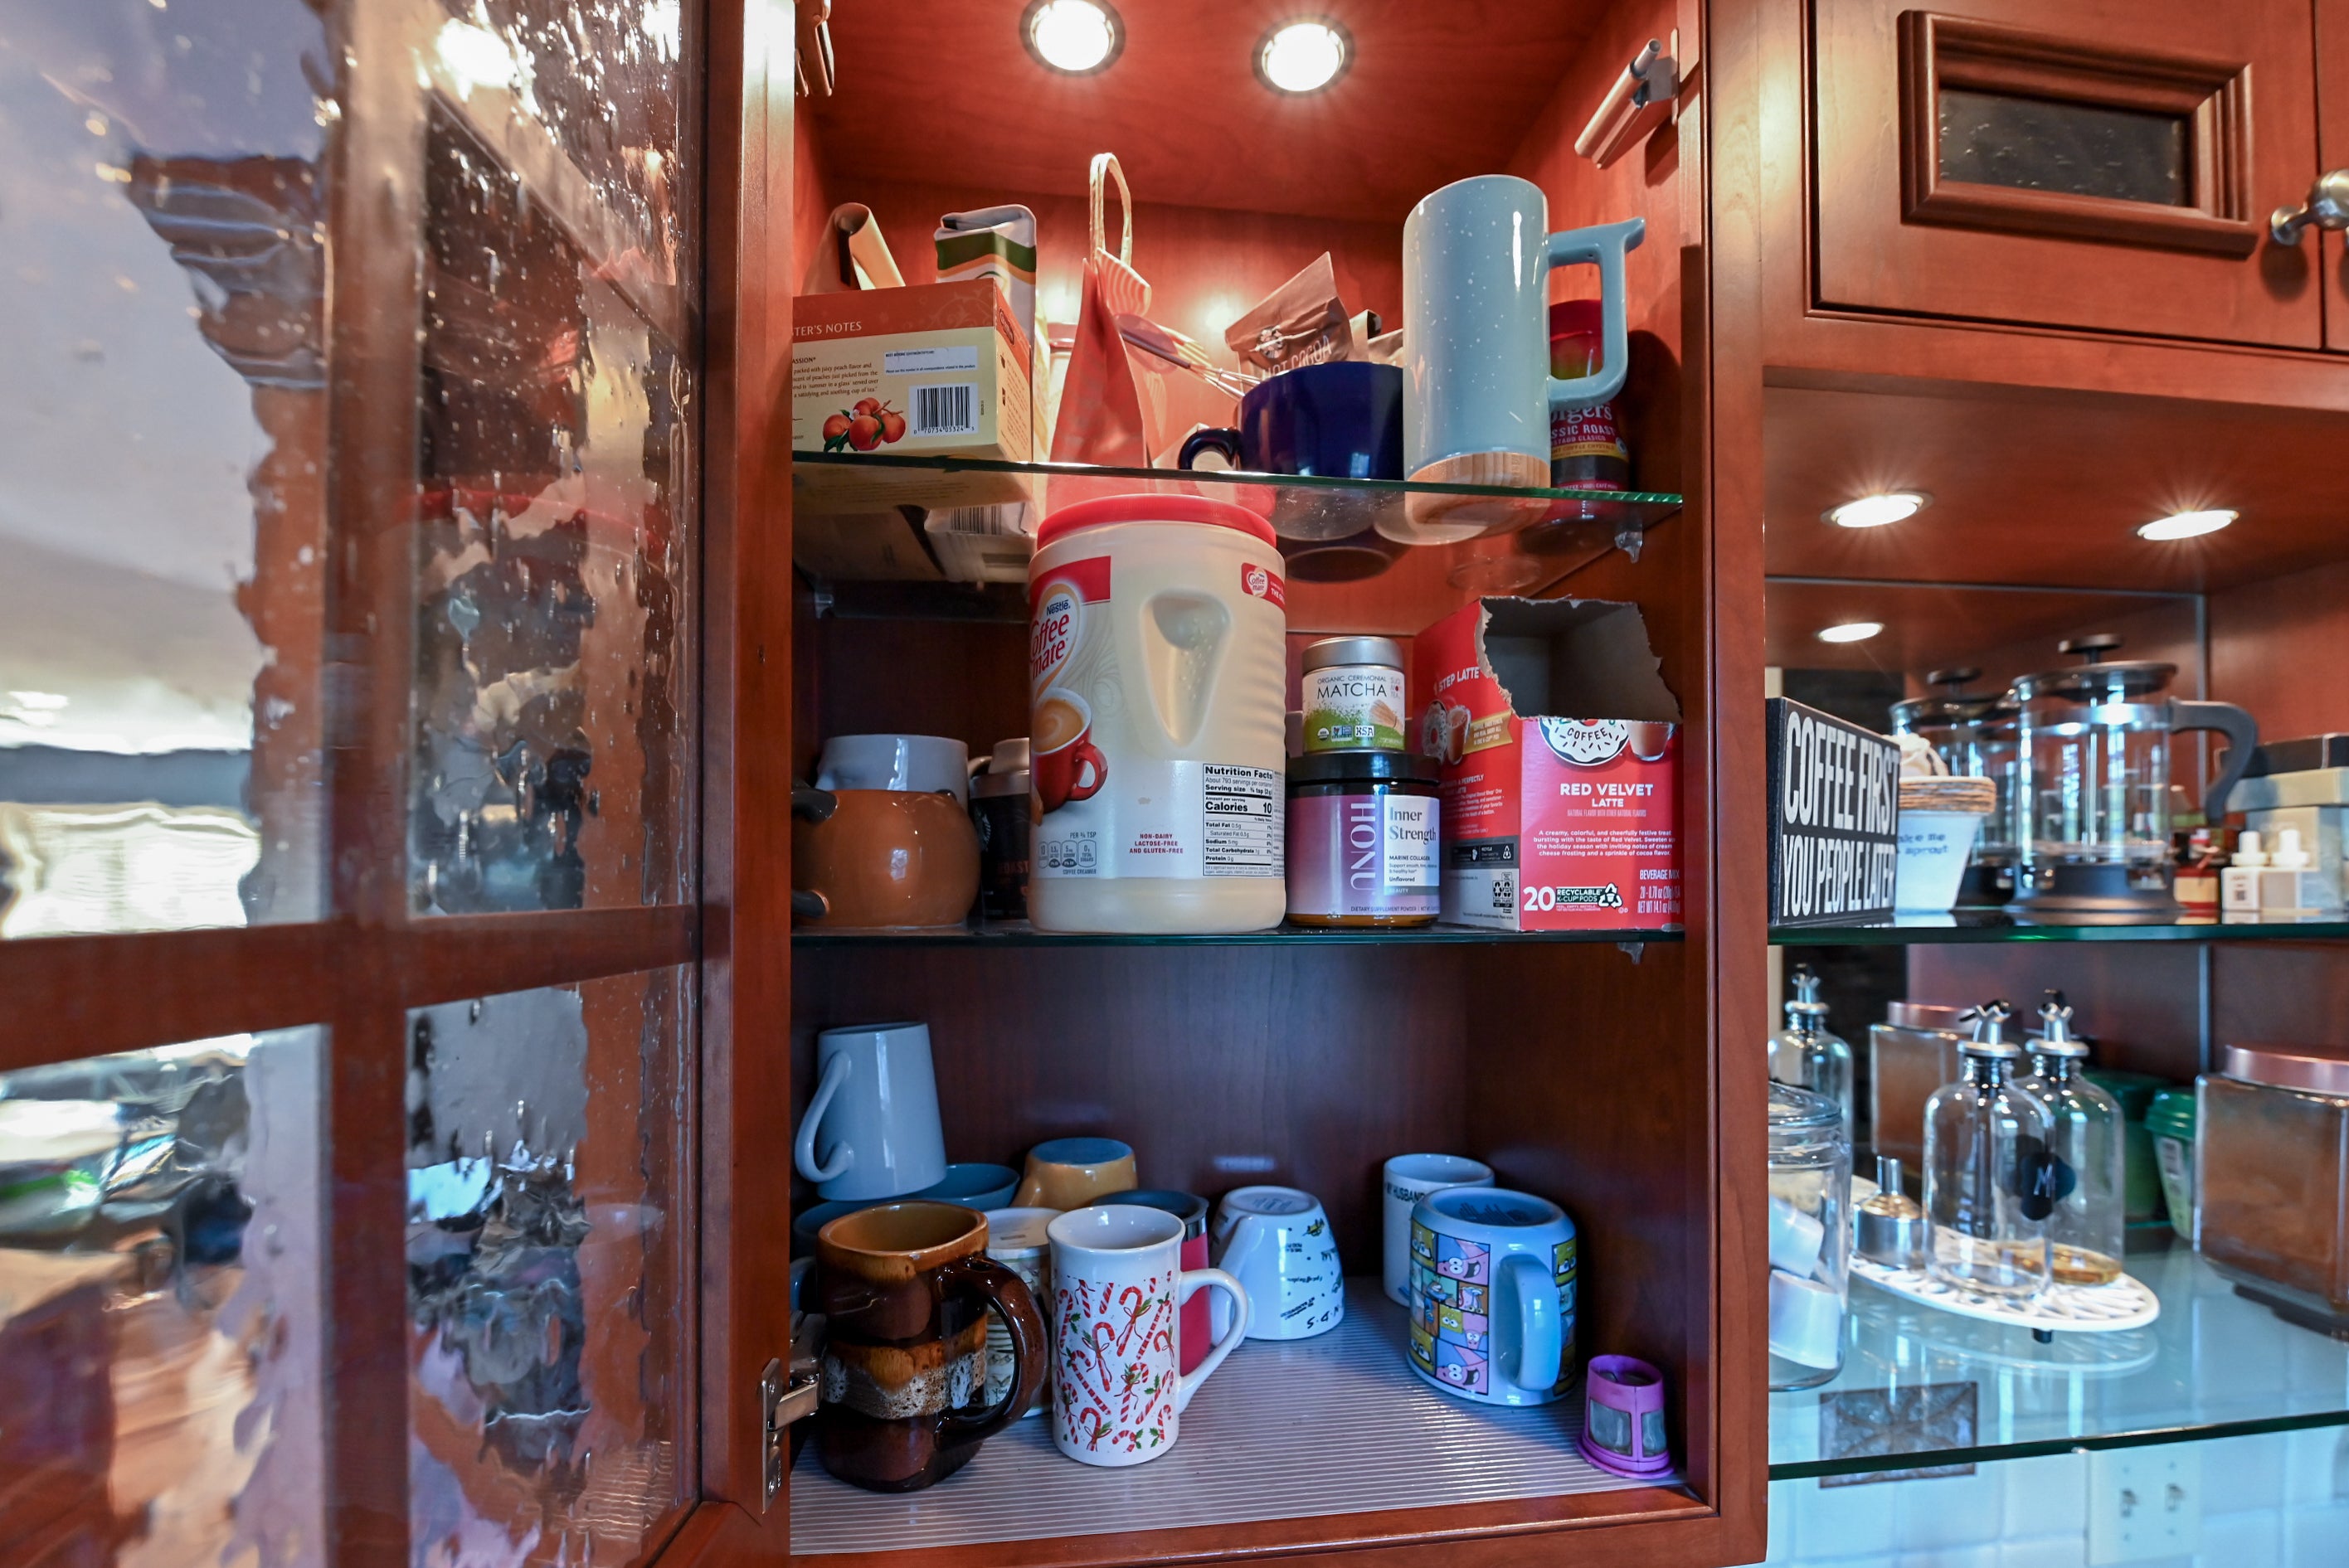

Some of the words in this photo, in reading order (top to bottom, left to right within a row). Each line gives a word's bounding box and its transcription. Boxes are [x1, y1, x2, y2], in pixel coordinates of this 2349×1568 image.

[825, 322, 862, 334] NOTES
[1291, 335, 1332, 370] COCOA
[841, 371, 857, 380] picked
[1583, 424, 1617, 436] ROAST
[1317, 675, 1345, 685] ORGANIC
[1348, 674, 1387, 682] CEREMONIAL
[1438, 673, 1456, 692] STEP
[1457, 667, 1481, 683] LATTE
[1317, 682, 1387, 700] MATCHA
[1355, 726, 1374, 736] KSA
[1567, 726, 1608, 741] COFFEE
[1205, 766, 1252, 777] Nutrition
[1254, 769, 1272, 779] Facts
[1784, 711, 1856, 830] COFFEE
[1857, 737, 1899, 835] FIRST
[1560, 783, 1592, 796] RED
[1596, 783, 1654, 797] VELVET
[1205, 801, 1248, 813] Calories
[1263, 802, 1272, 814] 10
[1591, 798, 1624, 808] LATTE
[1390, 807, 1423, 822] Inner
[1389, 825, 1437, 846] Strength
[1350, 803, 1376, 891] HONU
[1640, 869, 1668, 880] BEVERAGE
[1782, 834, 1815, 917] YOU
[1815, 837, 1865, 915] PEOPLE
[1863, 842, 1896, 910] LATER
[1523, 886, 1556, 911] 20
